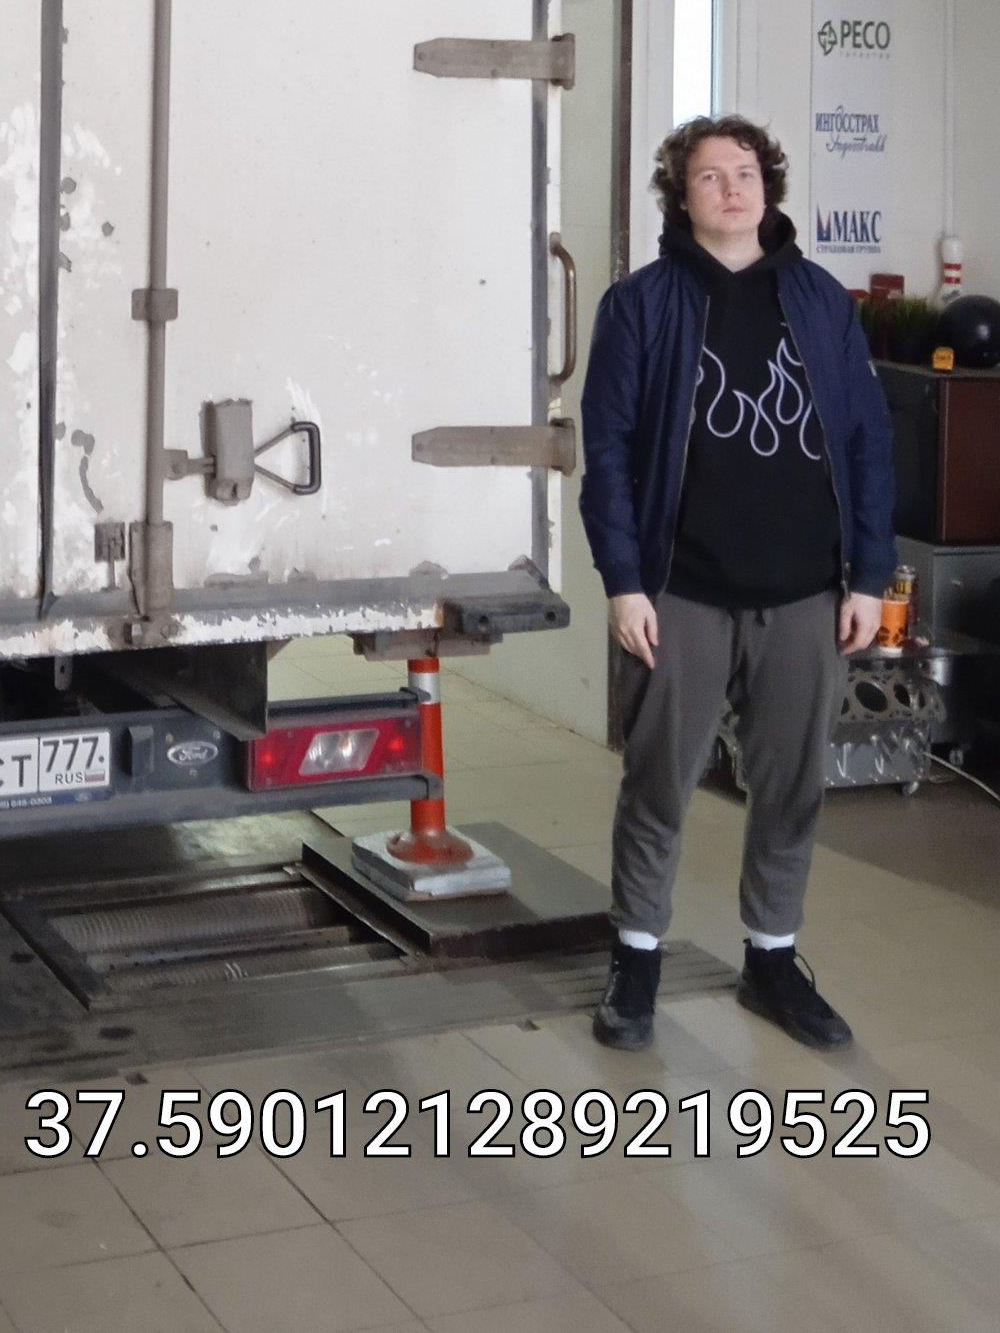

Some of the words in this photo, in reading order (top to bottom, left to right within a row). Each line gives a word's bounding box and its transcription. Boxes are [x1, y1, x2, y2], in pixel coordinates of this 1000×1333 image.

[840, 20, 892, 50] РЕСО
[42, 737, 101, 774] 777
[55, 772, 83, 786] RUS
